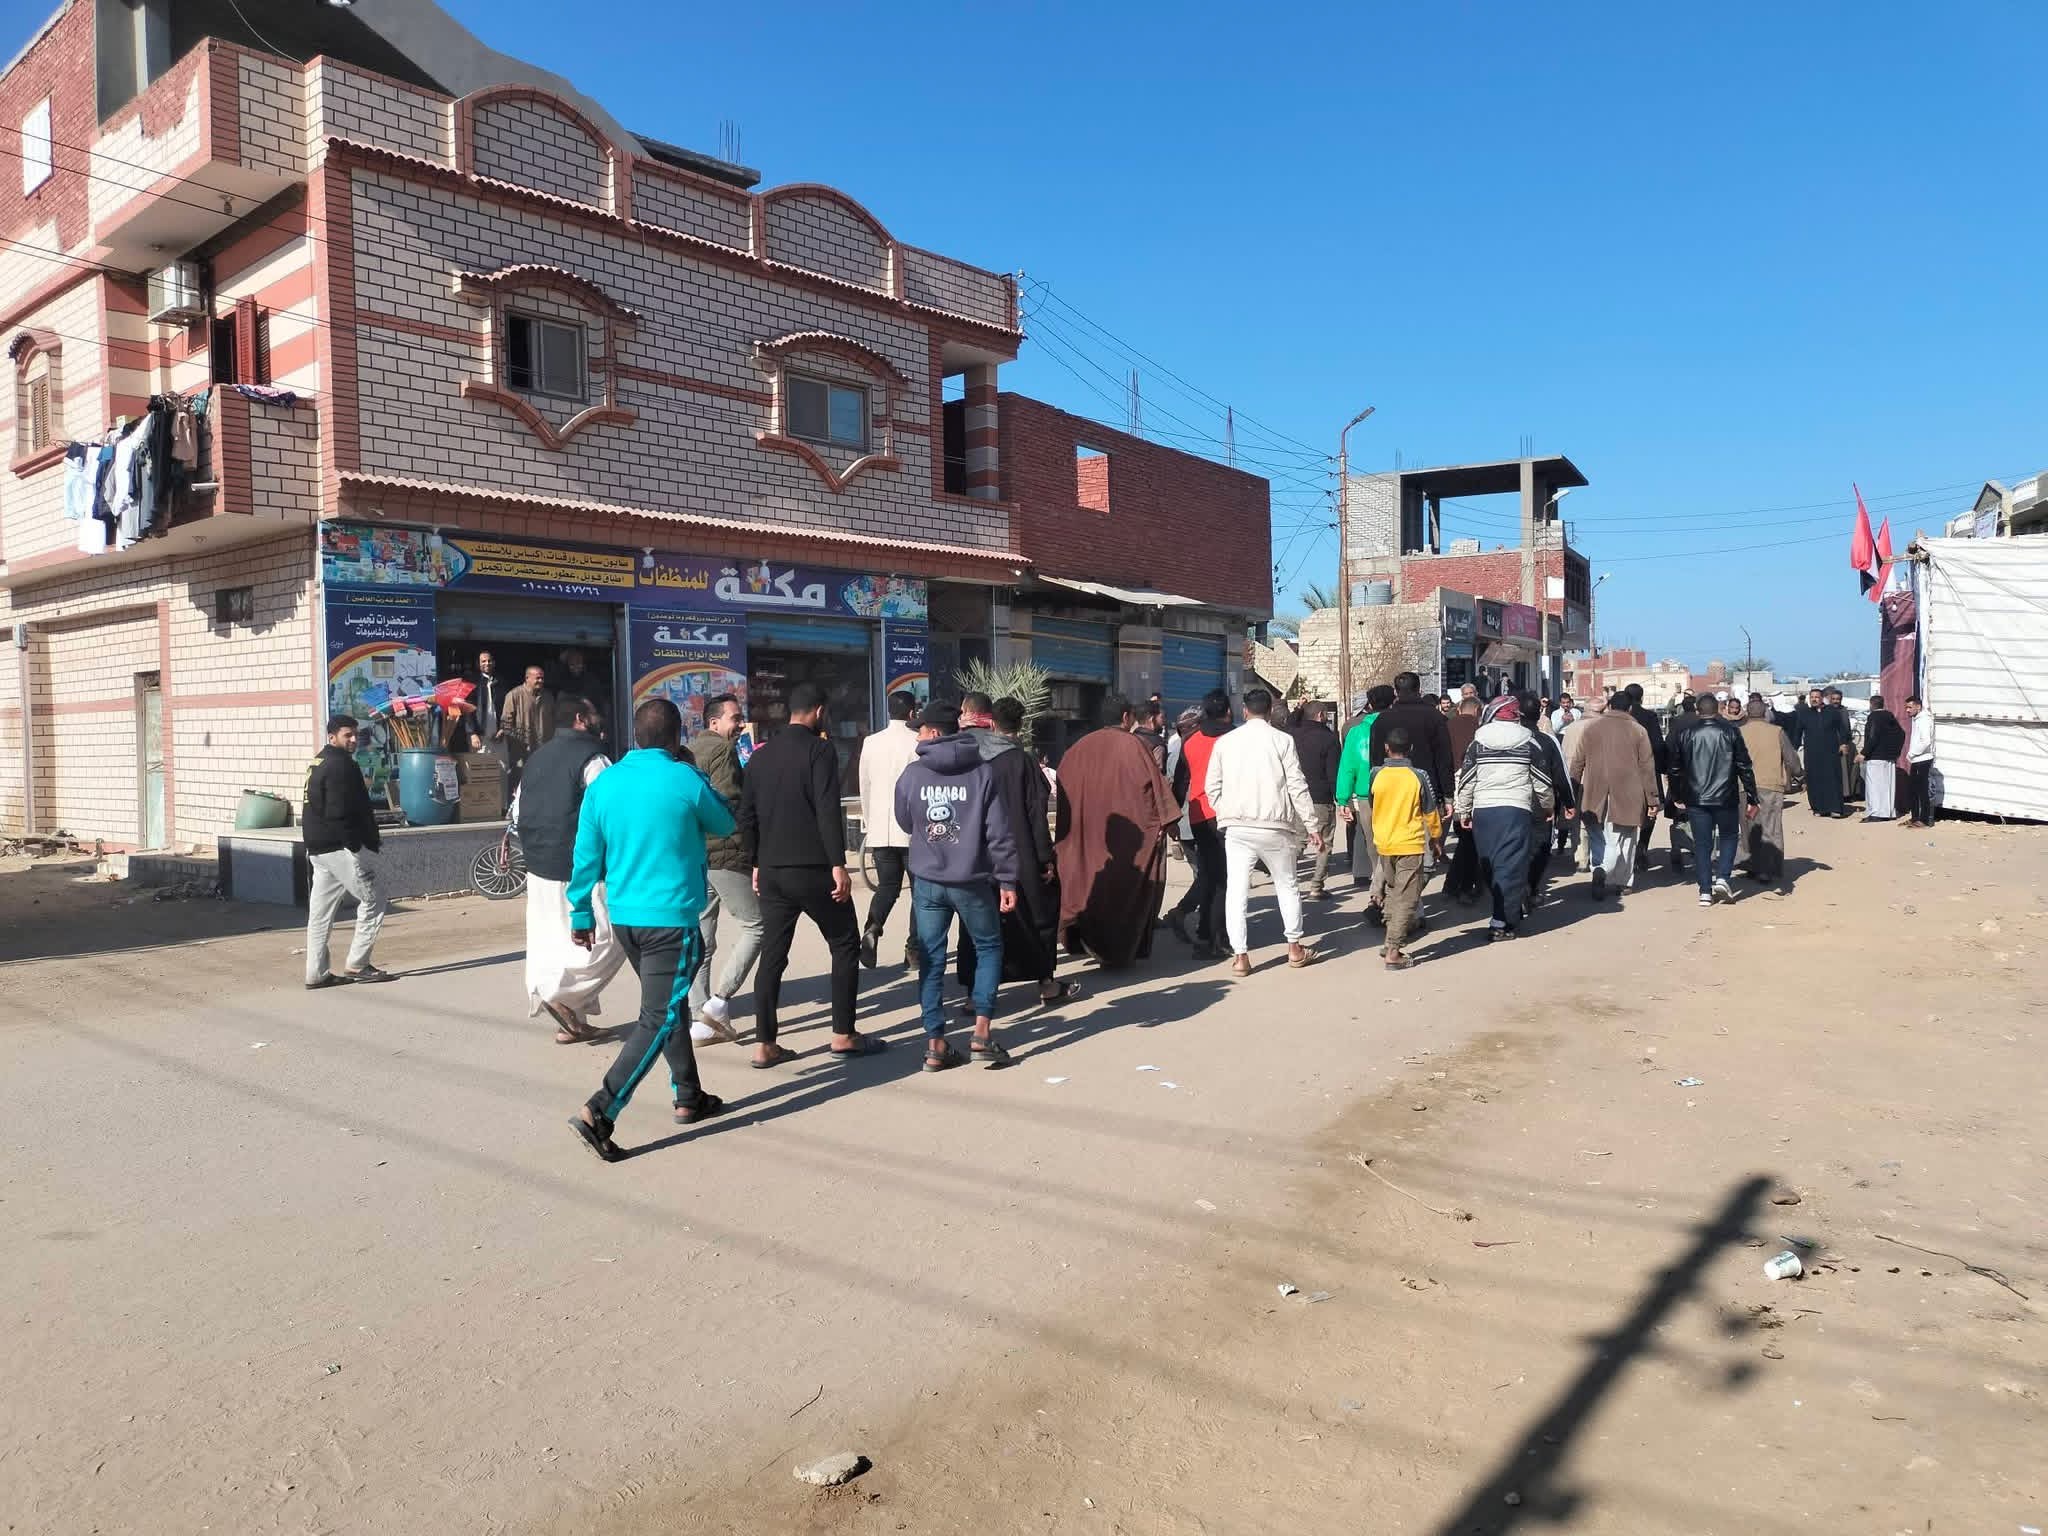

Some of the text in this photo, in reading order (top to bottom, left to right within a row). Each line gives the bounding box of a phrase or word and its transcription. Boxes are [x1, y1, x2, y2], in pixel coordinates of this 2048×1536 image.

[714, 567, 826, 608] مكة
[344, 612, 418, 627] مستحضرات تجميل
[653, 625, 729, 646] مكة
